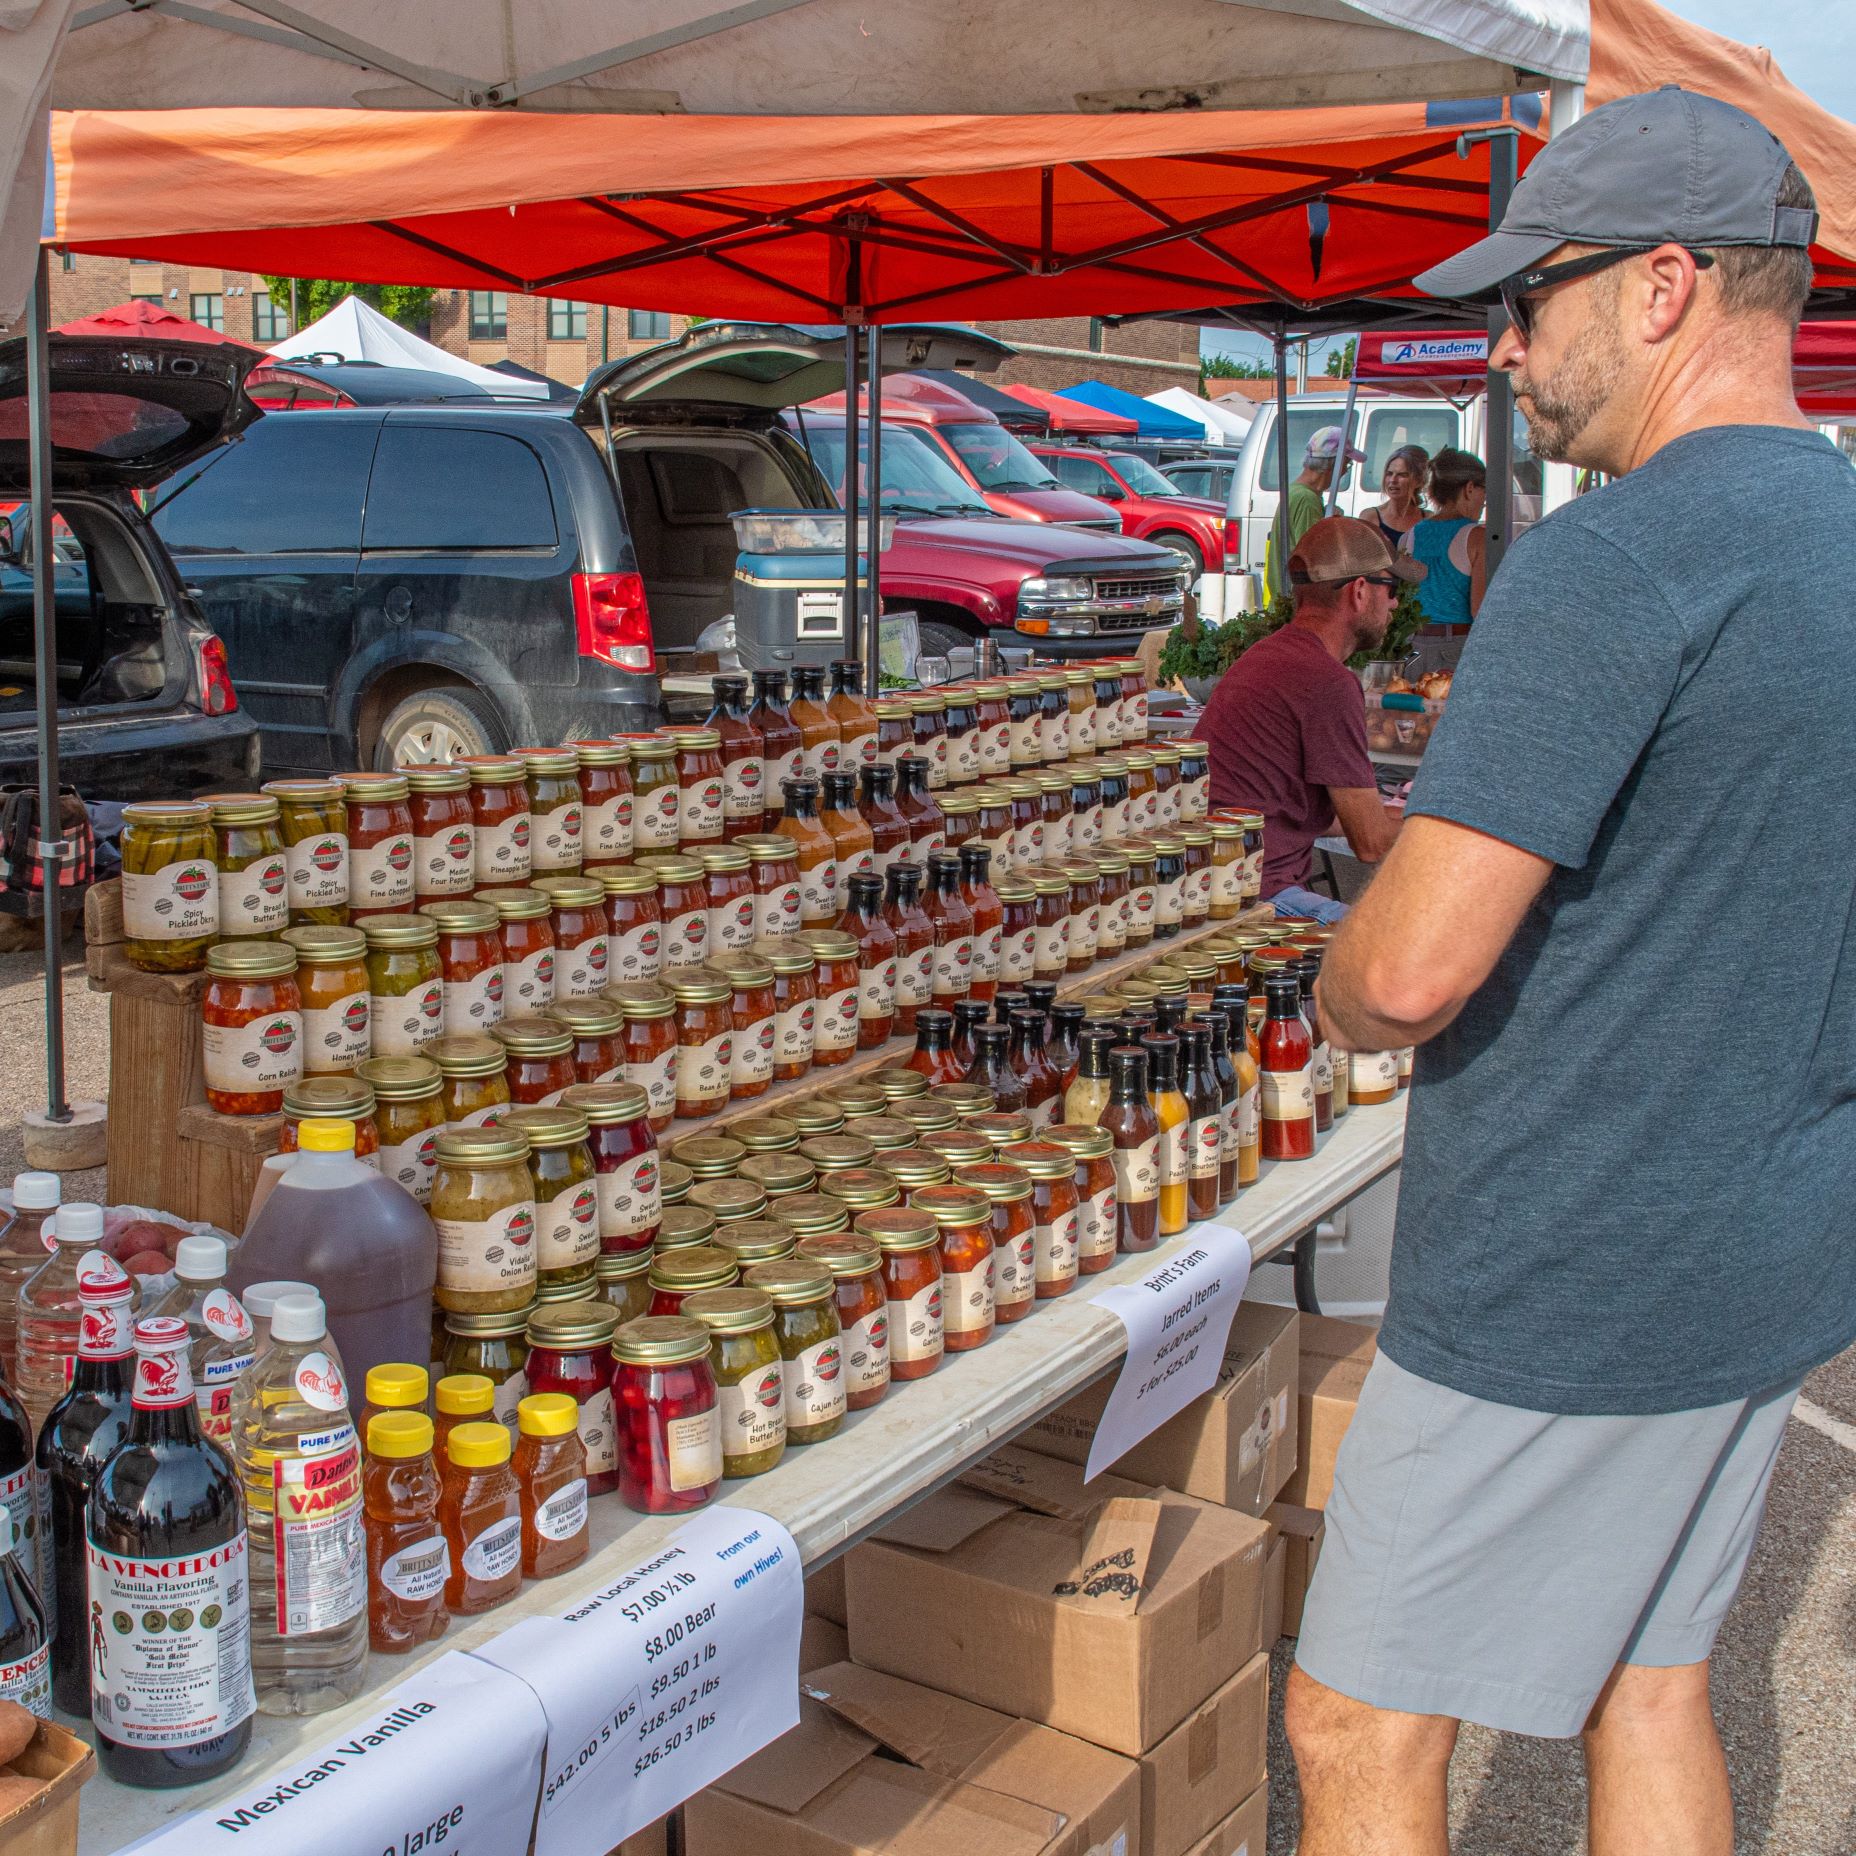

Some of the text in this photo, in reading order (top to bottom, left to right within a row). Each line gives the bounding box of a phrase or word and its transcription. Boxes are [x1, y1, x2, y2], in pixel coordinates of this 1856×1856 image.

[1419, 343, 1483, 355] Academy
[450, 868, 470, 876] Medium
[490, 865, 520, 874] Pineapple
[320, 880, 338, 889] Spicy
[396, 879, 407, 887] Mild
[431, 876, 468, 885] Four Pepper
[306, 888, 333, 898] Pickled
[370, 890, 386, 898] Fine
[184, 909, 204, 920] Spicy
[264, 903, 282, 913] Bread
[168, 914, 214, 929] Pickled Okra
[253, 911, 276, 924] Butter
[624, 973, 638, 981] Four
[948, 973, 961, 981] Apple
[423, 1026, 438, 1036] Bread
[332, 1052, 354, 1063] Honey
[258, 1067, 297, 1082] Corn Relish
[700, 1084, 715, 1092] Bean
[640, 1201, 656, 1213] Sweet
[631, 1214, 647, 1225] Baby
[579, 1230, 595, 1243] Sweet
[500, 1266, 522, 1278] Onion
[1144, 1249, 1209, 1293] Britt's Farm
[1012, 1283, 1031, 1294] Chunky
[1161, 1277, 1221, 1333] Jarred Items
[1153, 1332, 1185, 1367] $6.00
[1183, 1315, 1208, 1344] each
[207, 1364, 233, 1375] PURE
[862, 1367, 884, 1381] Chunky
[1137, 1386, 1146, 1400] 5
[1145, 1372, 1164, 1393] for
[1162, 1344, 1200, 1382] $25.00
[811, 1400, 832, 1413] Cajun
[749, 1428, 774, 1443] Butter
[752, 1423, 766, 1434] Hot
[300, 1434, 331, 1448] PURE
[557, 1509, 583, 1525] All Natural
[290, 1518, 337, 1532] PURE MEXICAN
[554, 1514, 585, 1535] RAW HONEY
[716, 1529, 762, 1561] From our
[489, 1553, 498, 1563] All
[500, 1550, 518, 1568] HONEY
[401, 1557, 432, 1574] BRITT'S
[733, 1549, 784, 1590] own Hives!
[411, 1568, 442, 1583] All Natural
[114, 1578, 153, 1593] Vanilla
[157, 1574, 215, 1592] Flavoring
[407, 1576, 444, 1595] RAW HONEY
[564, 1547, 686, 1622] Raw Local Honey
[110, 1589, 133, 1600] CONTAINS
[169, 1589, 200, 1600] ARTIFICIAL
[200, 1583, 219, 1595] FLAVOR
[621, 1587, 667, 1623] $7.00
[680, 1570, 697, 1591] lb
[131, 1600, 200, 1610] ESTABLISHED 1917
[645, 1601, 716, 1663] $8.00 Bear
[168, 1652, 190, 1661] Medal
[146, 1661, 164, 1669] First
[650, 1642, 717, 1699] $9.50 1 lb
[638, 1675, 720, 1742] $18.50 2 lbs
[545, 1701, 637, 1801] $42.00 5 lbs
[633, 1711, 716, 1778] $26.50 3 lbs
[216, 1700, 437, 1832] Mexican Vanilla
[402, 1804, 465, 1856] large
